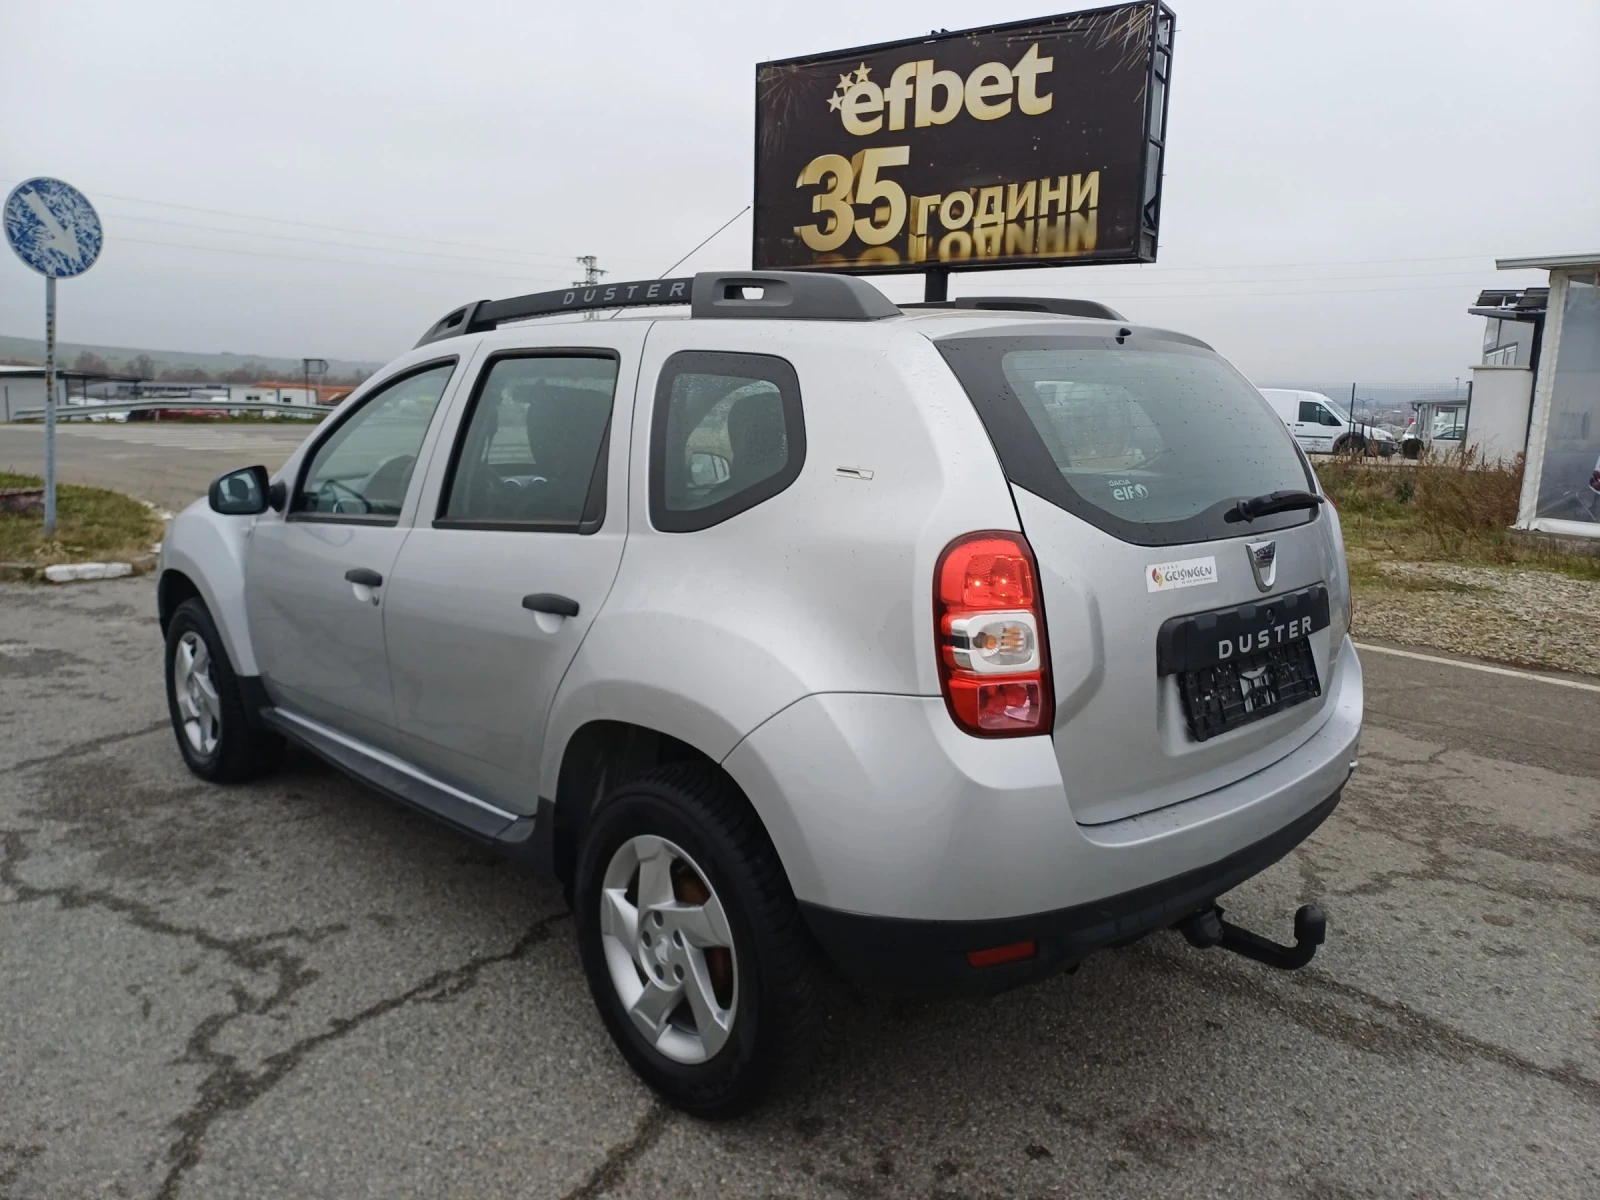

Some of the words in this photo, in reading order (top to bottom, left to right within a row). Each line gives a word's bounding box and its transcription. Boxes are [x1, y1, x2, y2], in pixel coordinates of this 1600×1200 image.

[841, 43, 1054, 136] efbet
[794, 146, 910, 252] 35
[563, 282, 686, 305] DUSTER
[1113, 485, 1135, 501] elf
[1165, 565, 1212, 582] GEISINGEN
[1218, 616, 1312, 659] DUSTER
